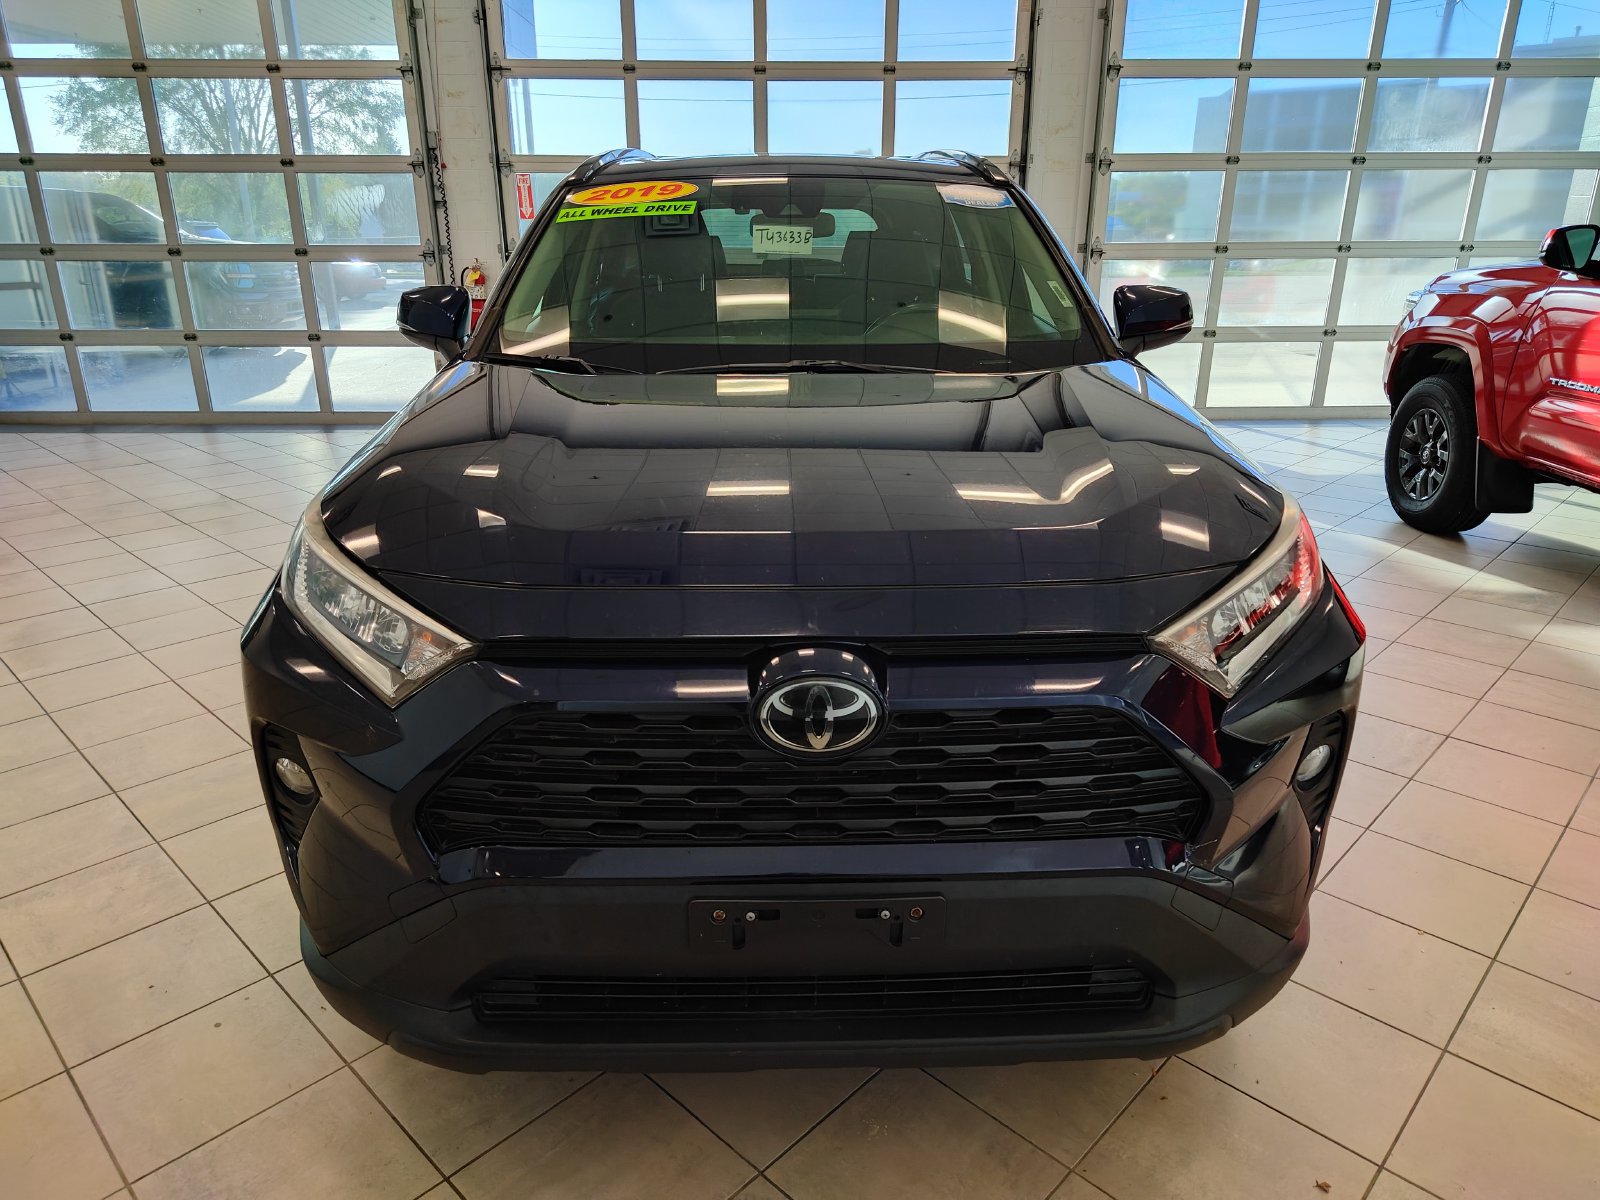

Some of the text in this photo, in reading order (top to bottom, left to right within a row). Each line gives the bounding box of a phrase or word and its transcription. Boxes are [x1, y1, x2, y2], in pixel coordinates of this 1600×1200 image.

[583, 184, 683, 202] 2019
[560, 204, 693, 220] ALL WHEEL DRIVE
